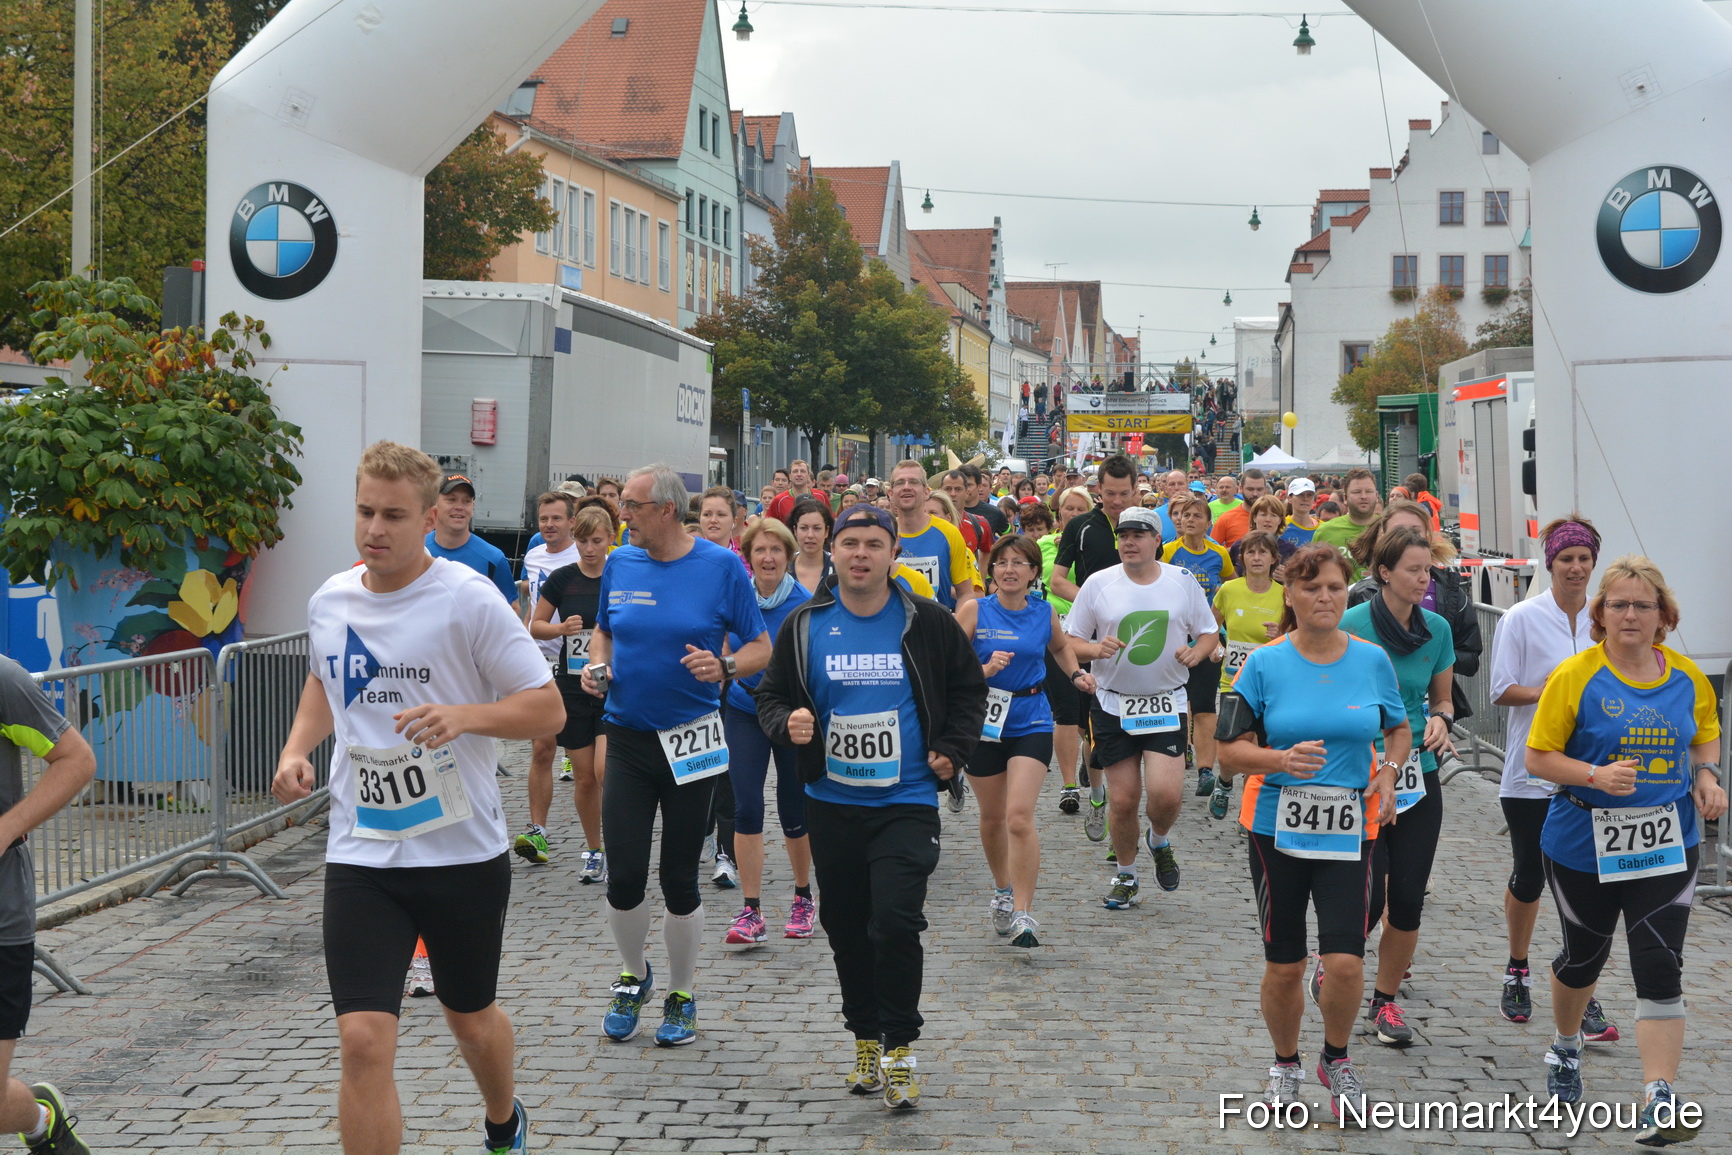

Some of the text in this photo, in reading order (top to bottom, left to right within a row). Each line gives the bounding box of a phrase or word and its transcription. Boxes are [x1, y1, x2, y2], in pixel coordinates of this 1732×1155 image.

[1606, 168, 1713, 212] BMW
[236, 183, 330, 224] BMW
[677, 383, 706, 426] BOCK
[1107, 418, 1151, 428] START
[825, 653, 904, 671] HUBER
[355, 687, 404, 704] Team
[1125, 696, 1173, 716] 2286
[846, 720, 885, 730] Neumarkt
[1135, 717, 1166, 728] Michael
[668, 722, 721, 758] 2274
[830, 730, 894, 760] 2860
[350, 752, 409, 767] PARTL Neumarkt
[686, 754, 722, 772] Siegfried
[845, 766, 876, 777] Andre
[359, 765, 427, 805] 3310
[1282, 788, 1348, 802] PARTL Neumarkt
[1285, 801, 1355, 831] 3416
[1594, 807, 1664, 823] PARTL Neumarkt
[1603, 817, 1674, 853] 2792
[1617, 853, 1665, 870] Gabriele
